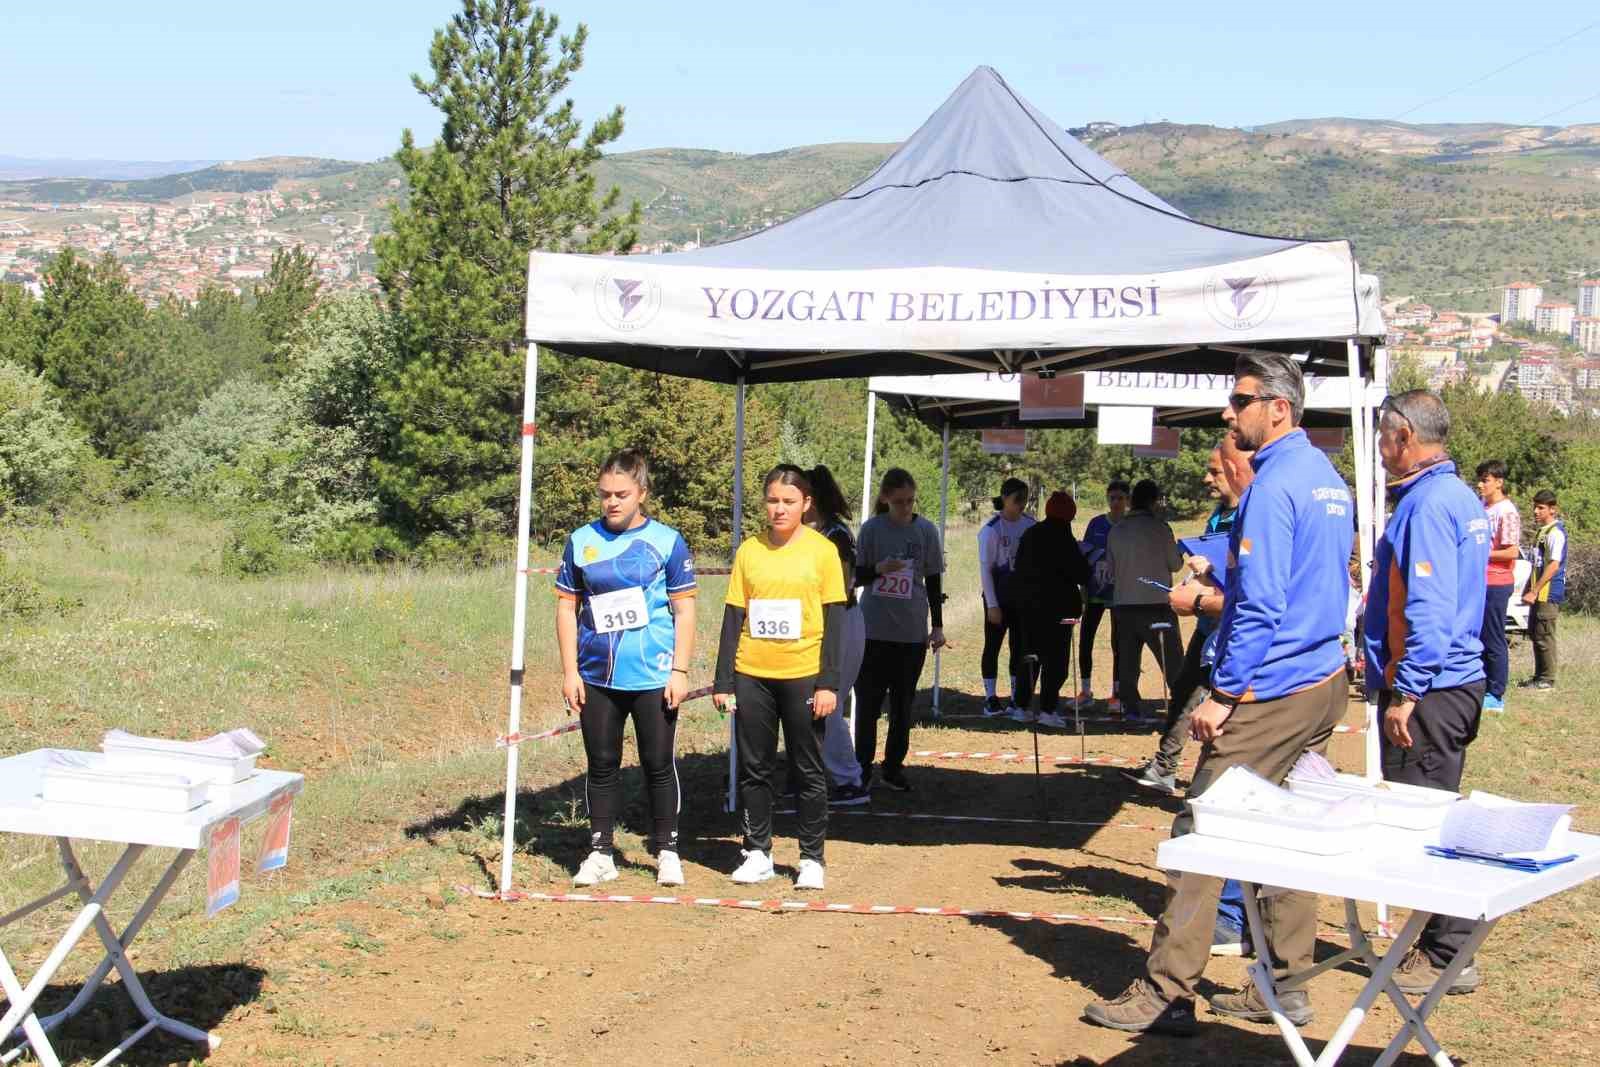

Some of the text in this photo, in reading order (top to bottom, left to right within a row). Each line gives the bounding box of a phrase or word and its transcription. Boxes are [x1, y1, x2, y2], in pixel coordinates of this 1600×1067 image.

[701, 287, 875, 321] YOZGAT
[886, 279, 1161, 321] BELEDİYESİ
[878, 575, 910, 595] 220
[604, 609, 638, 628] 319
[757, 620, 791, 635] 336
